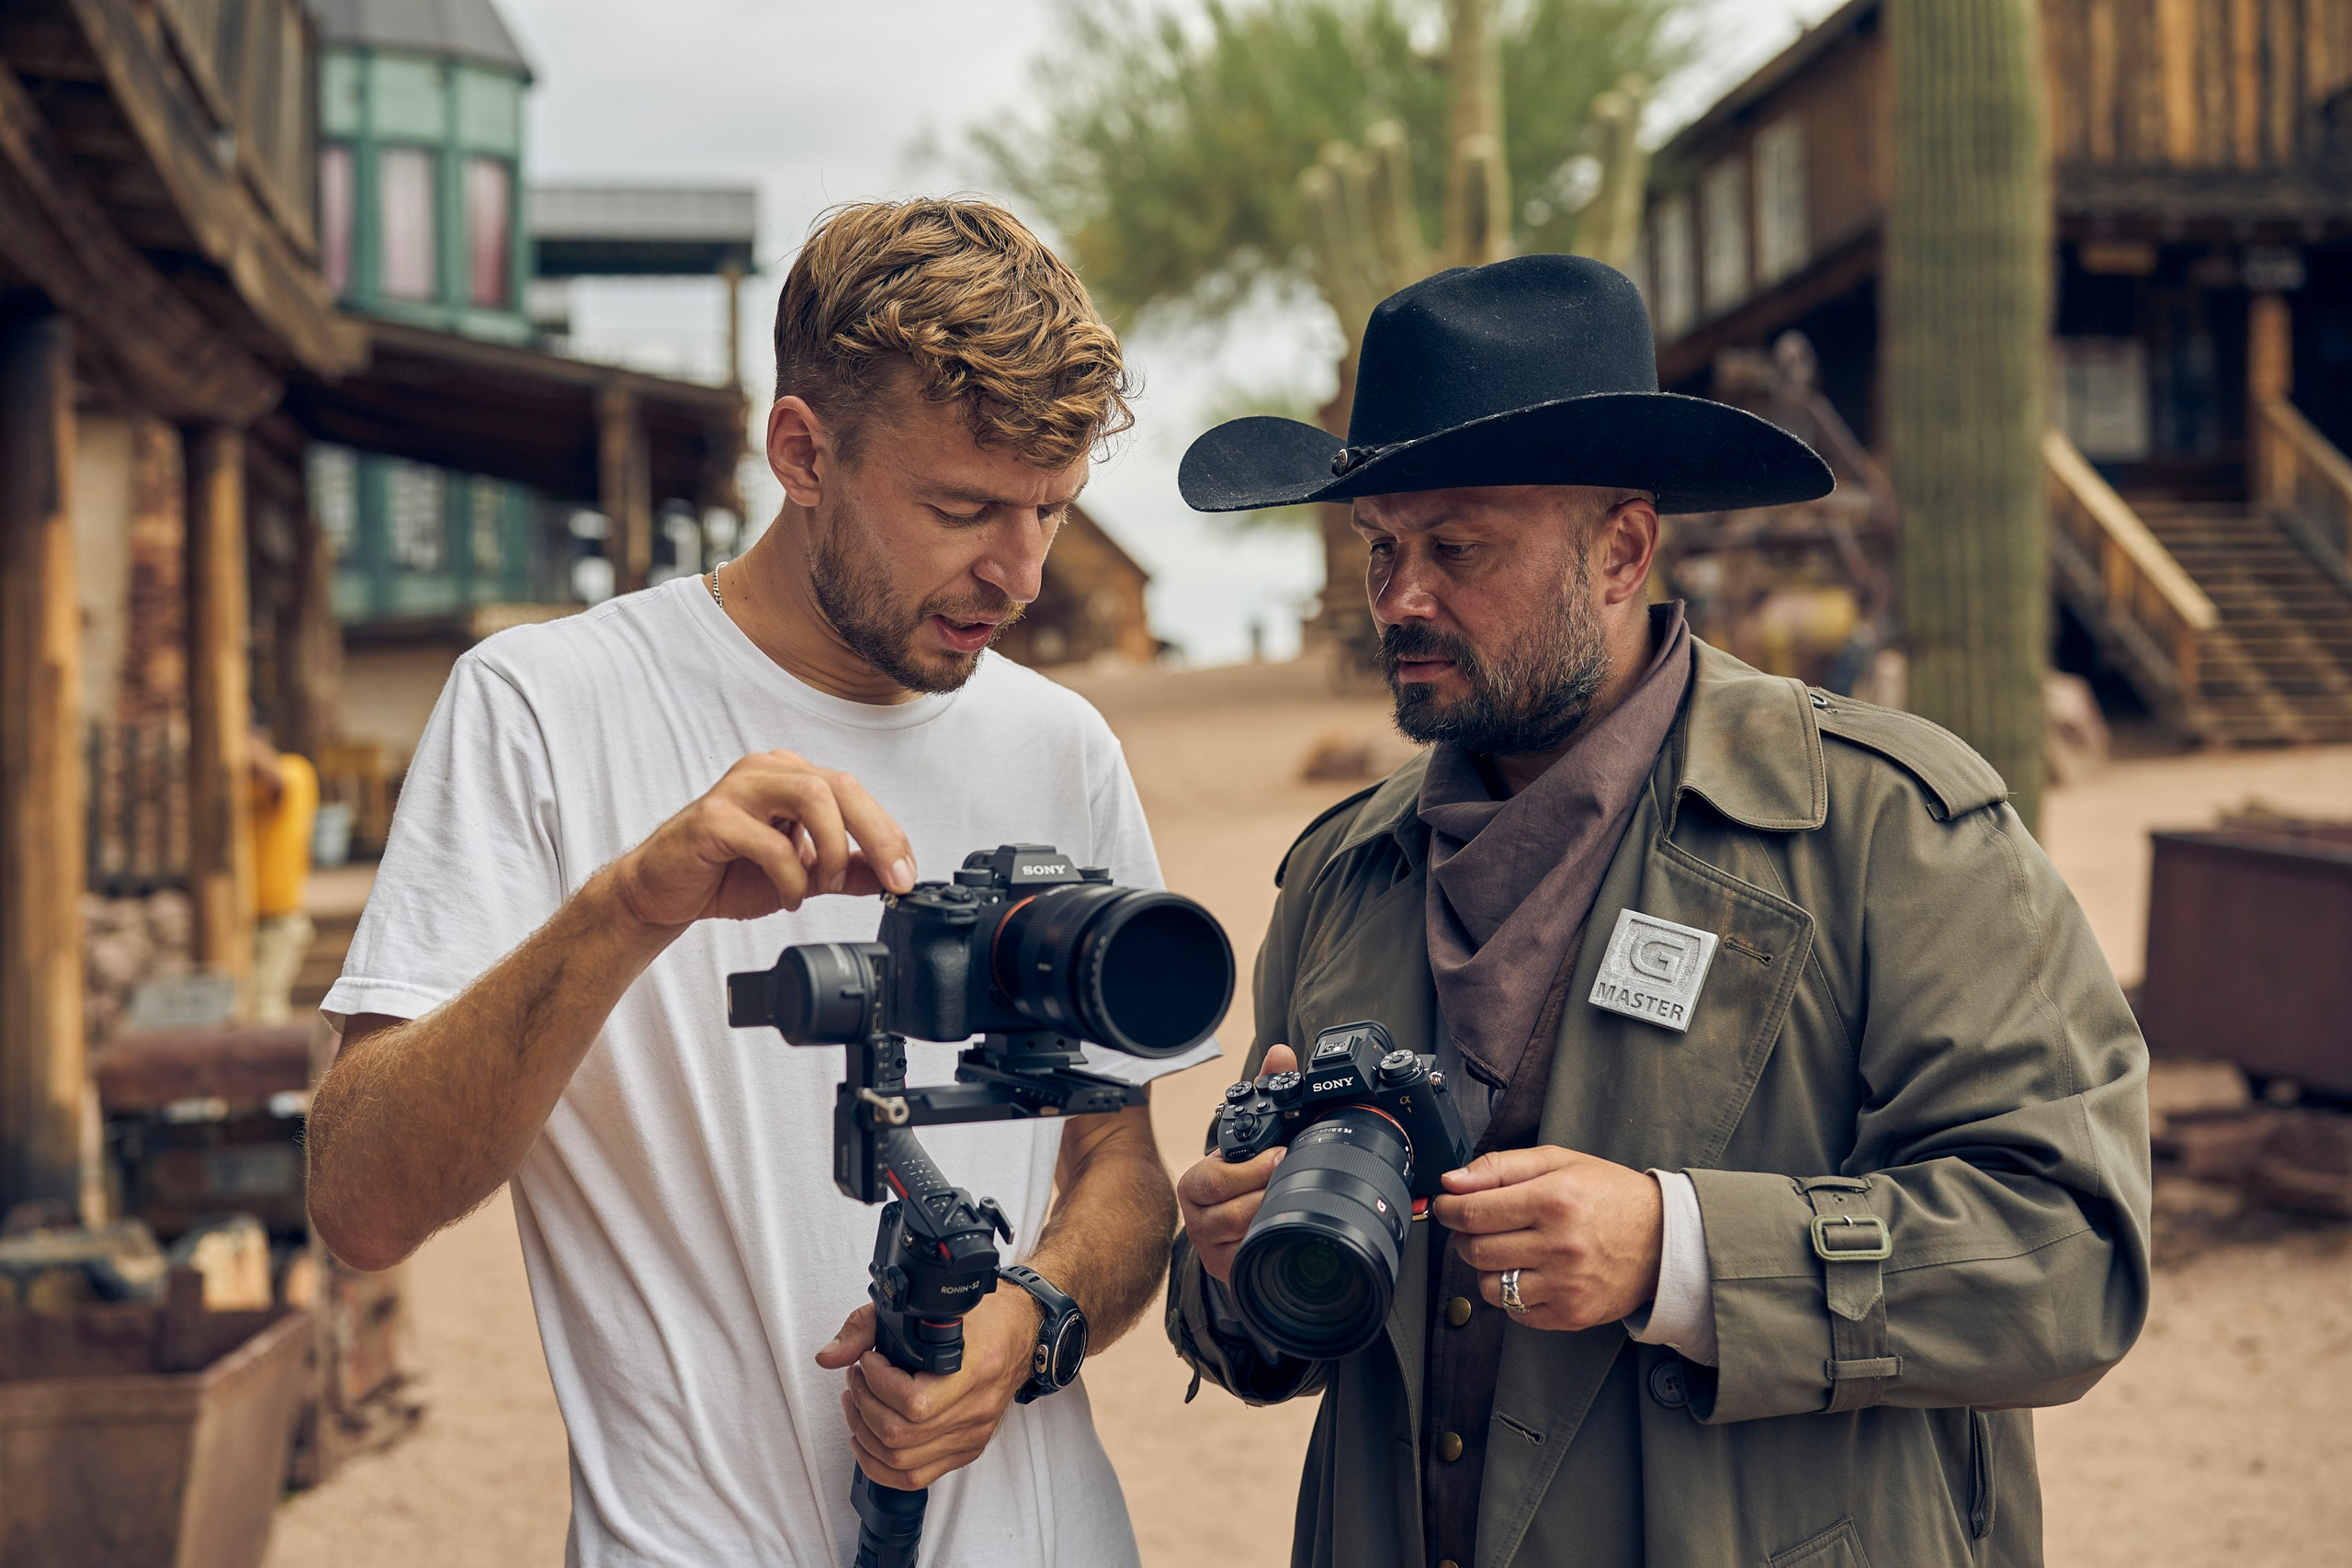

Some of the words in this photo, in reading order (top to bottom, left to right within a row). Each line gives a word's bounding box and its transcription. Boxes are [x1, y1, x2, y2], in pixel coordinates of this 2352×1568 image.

[1022, 864, 1067, 876] SONY
[1629, 934, 1686, 984] G
[1596, 981, 1684, 1021] MASTER
[1312, 1076, 1354, 1093] SONY
[1377, 1198, 1387, 1213] G
